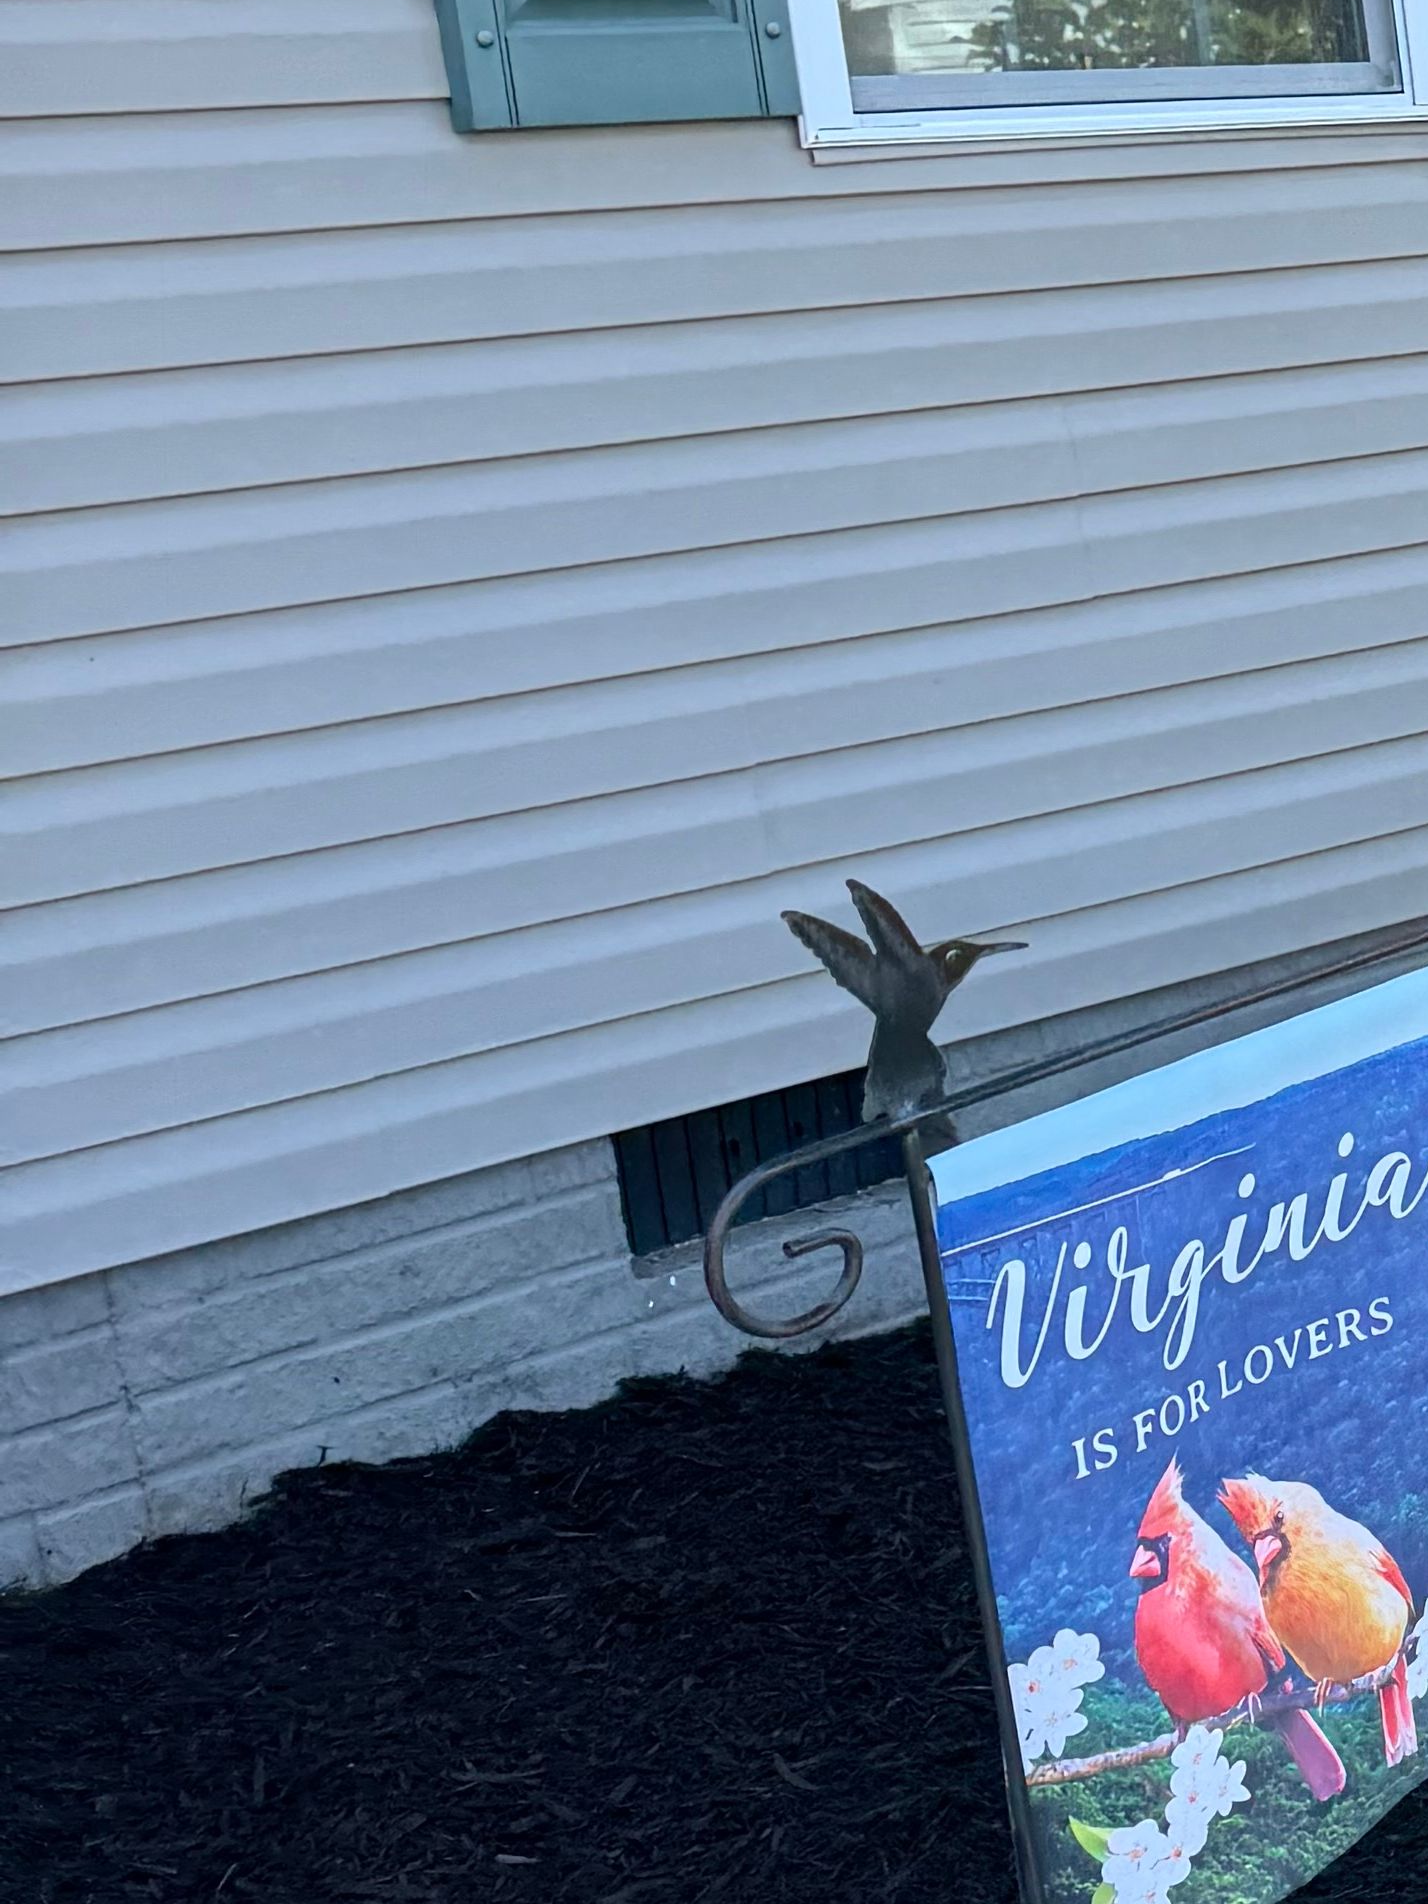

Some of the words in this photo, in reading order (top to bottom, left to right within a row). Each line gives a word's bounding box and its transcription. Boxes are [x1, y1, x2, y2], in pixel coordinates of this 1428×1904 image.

[1071, 1428, 1119, 1480] IS
[1132, 1379, 1210, 1453] FOR
[1217, 1296, 1394, 1399] LOVERS
